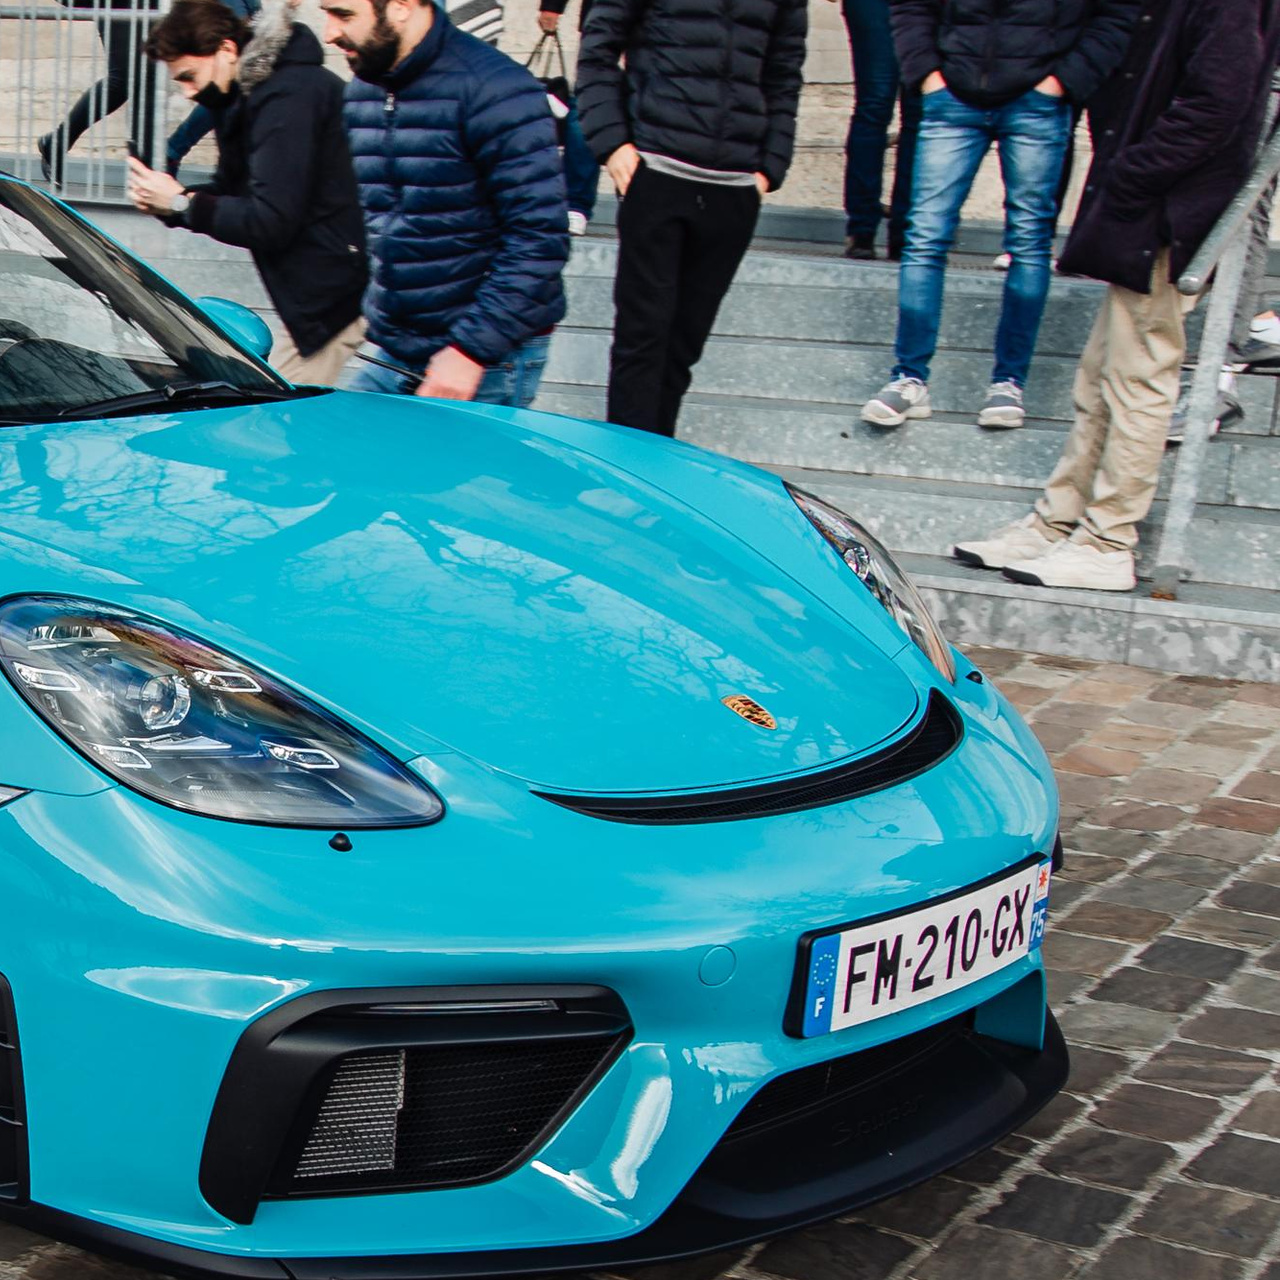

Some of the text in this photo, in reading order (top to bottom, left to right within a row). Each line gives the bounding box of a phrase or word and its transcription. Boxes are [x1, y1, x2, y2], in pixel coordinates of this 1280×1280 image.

[1030, 908, 1046, 942] 75
[843, 883, 1031, 1013] FM-210-GX
[814, 996, 825, 1018] F
